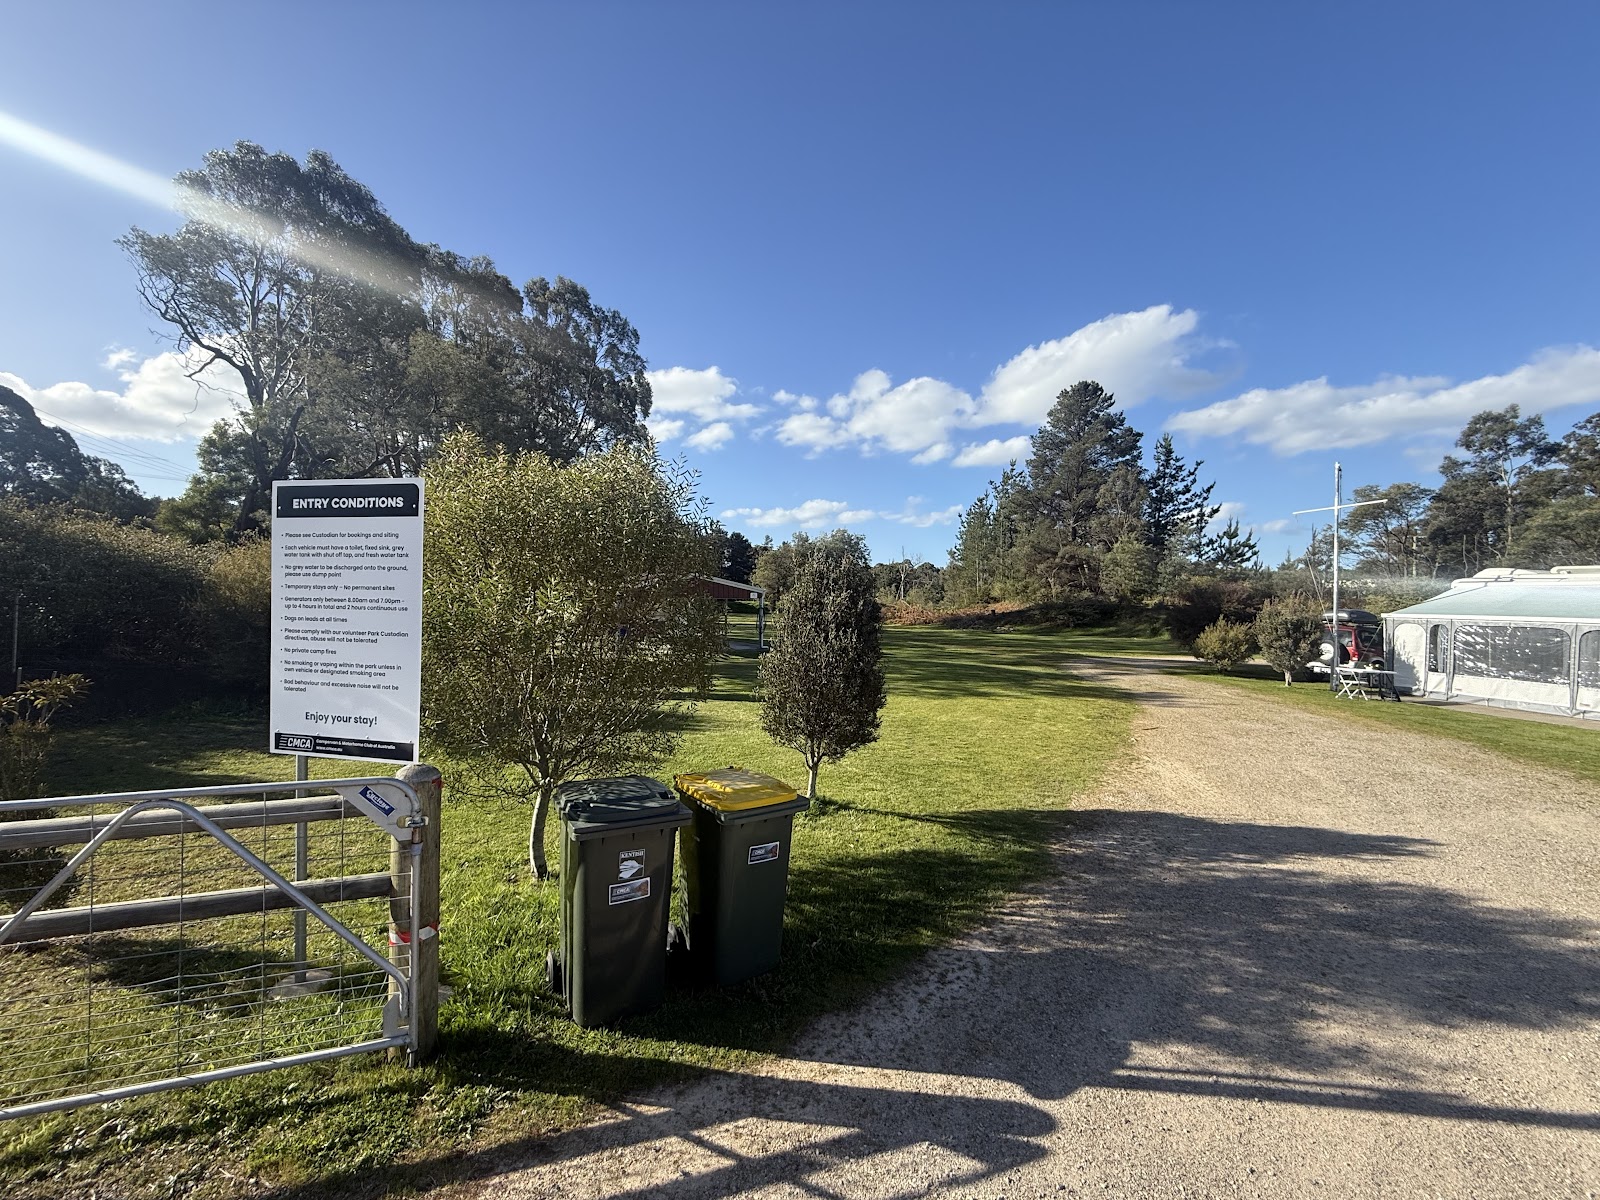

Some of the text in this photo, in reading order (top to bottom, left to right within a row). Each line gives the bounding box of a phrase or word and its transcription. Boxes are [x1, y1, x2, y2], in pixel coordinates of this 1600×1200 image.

[292, 497, 404, 509] ENTRY CONDITIONS
[306, 712, 377, 727] Enjoy your stay!
[288, 738, 311, 748] CMCA
